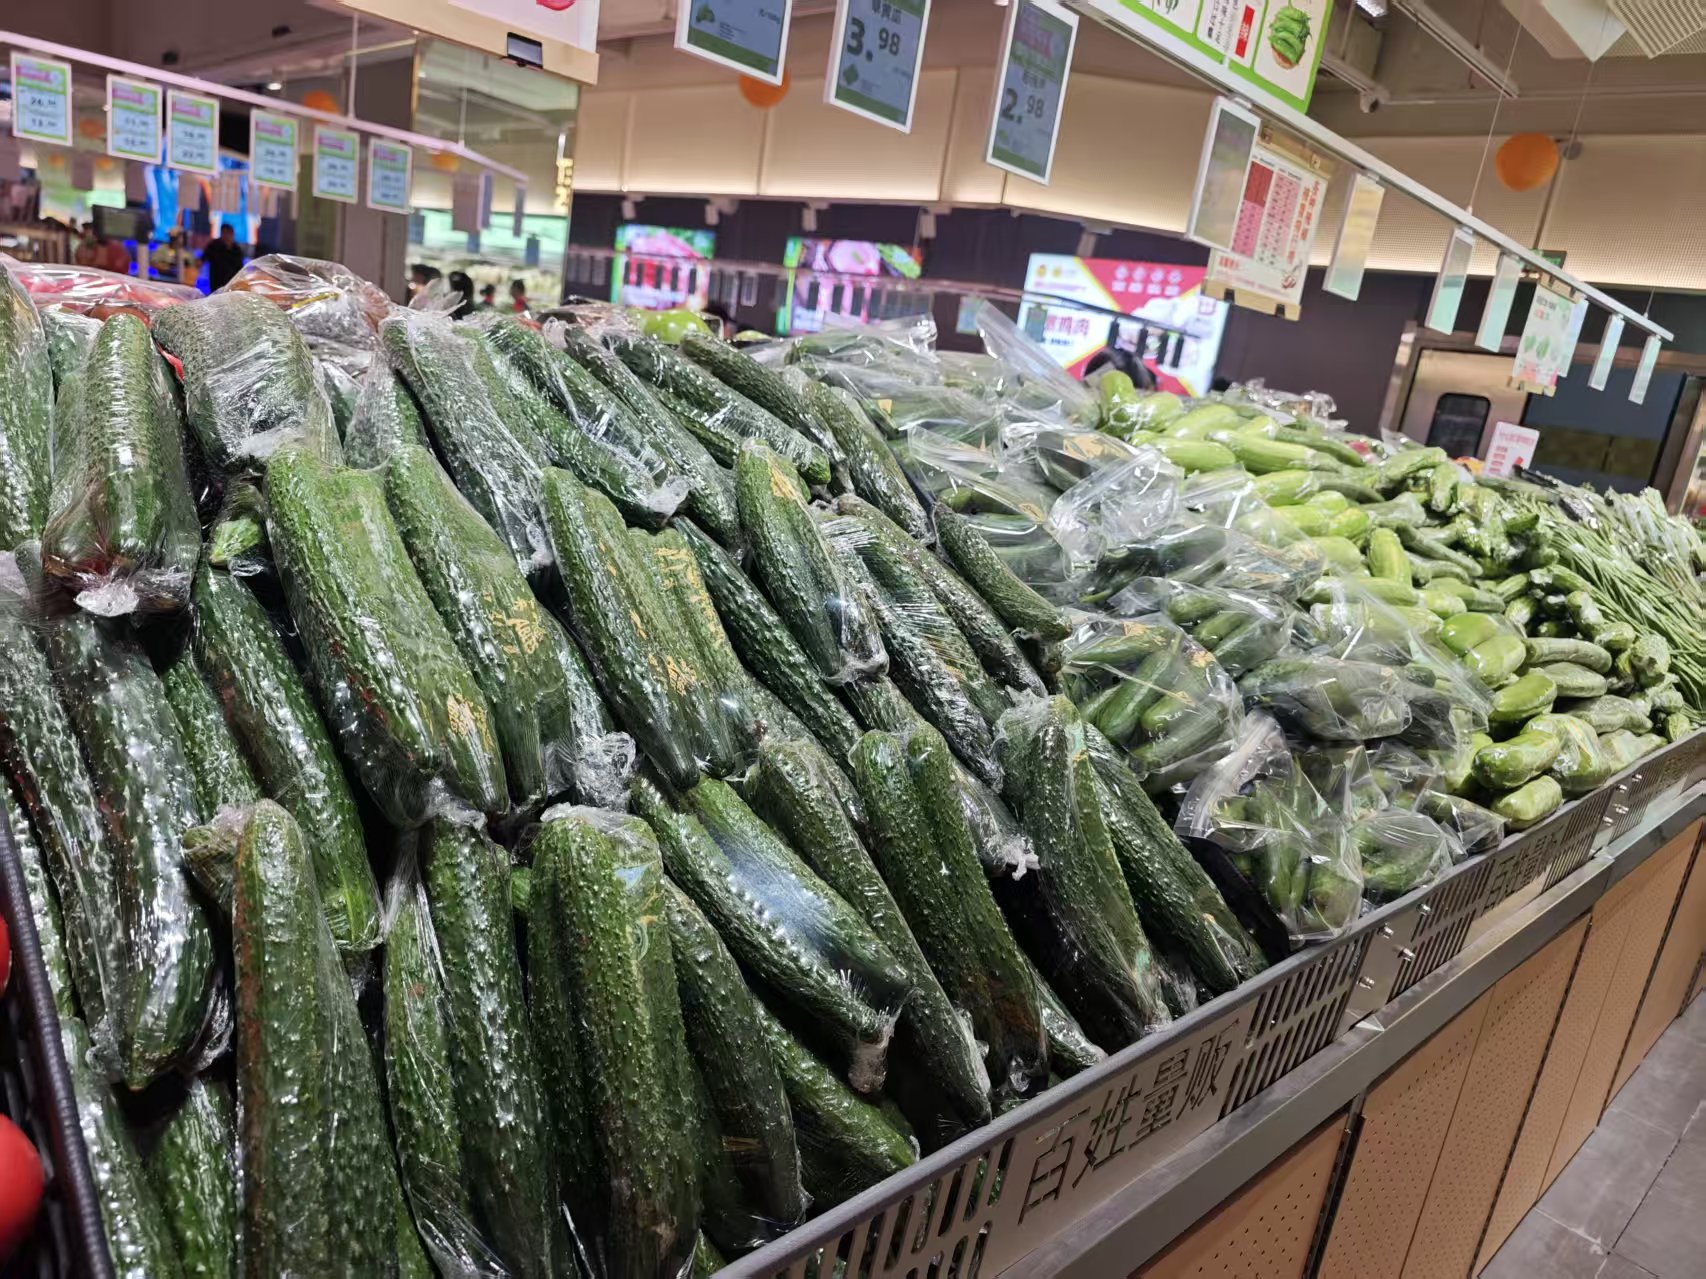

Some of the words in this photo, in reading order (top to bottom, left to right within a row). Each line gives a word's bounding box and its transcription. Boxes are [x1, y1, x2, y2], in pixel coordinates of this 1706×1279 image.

[847, 17, 901, 62] 3.98
[1001, 88, 1045, 124] 2.98
[1017, 1018, 1240, 1226] 百姓量贩
